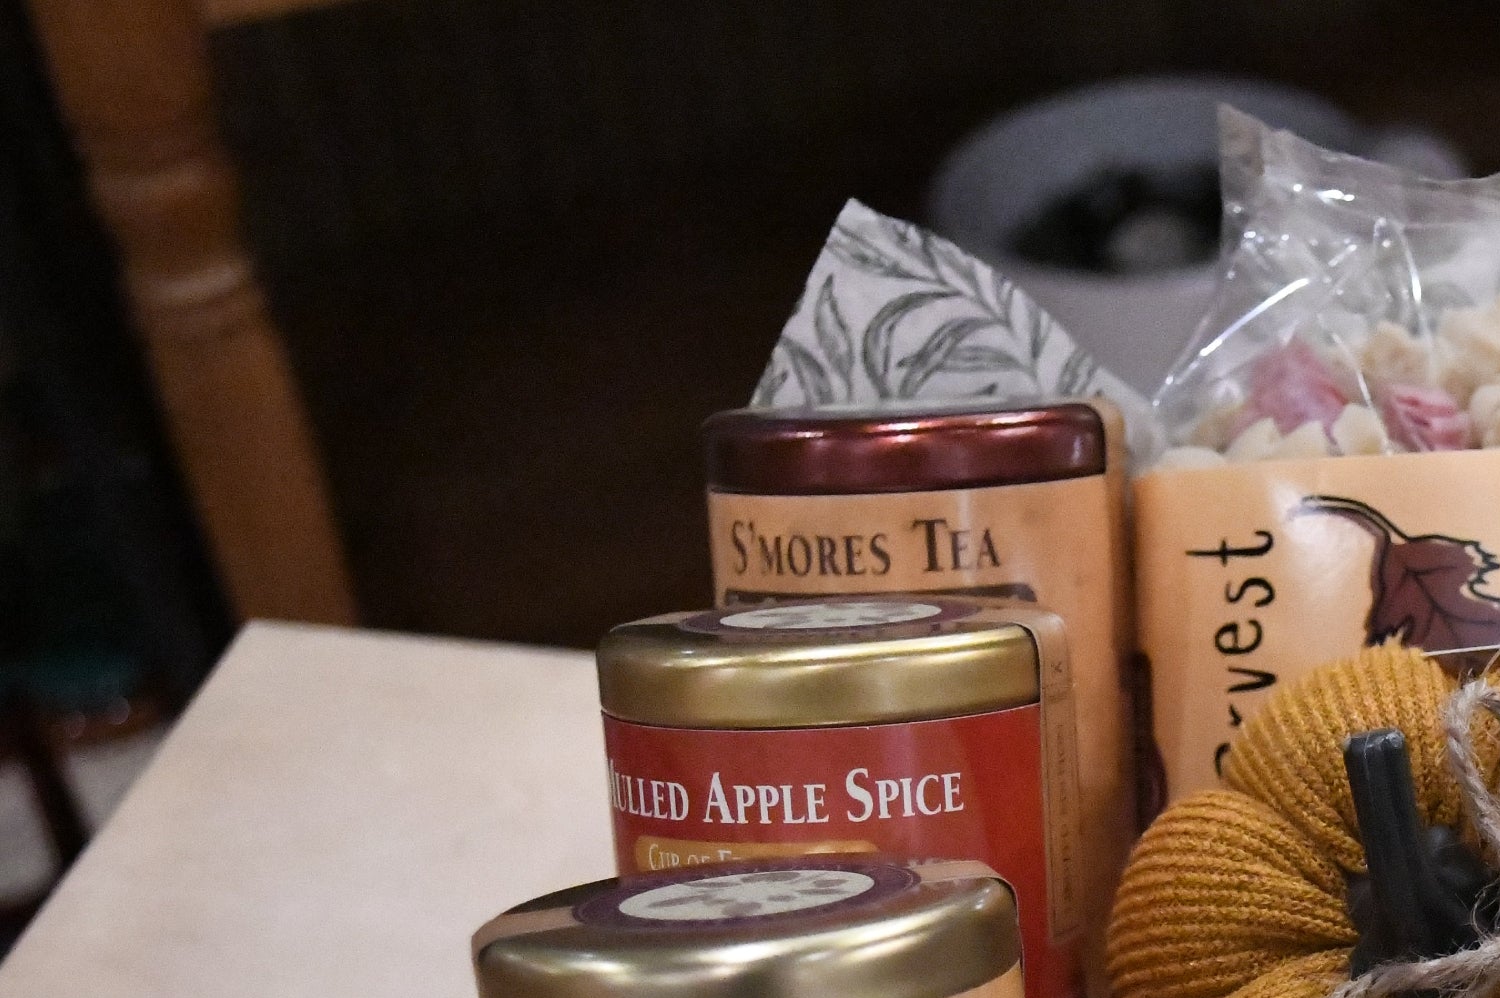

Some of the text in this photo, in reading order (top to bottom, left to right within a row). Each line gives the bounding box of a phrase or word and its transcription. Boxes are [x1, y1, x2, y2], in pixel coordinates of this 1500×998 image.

[731, 518, 1002, 578] S'MORES TEA
[703, 771, 830, 825] APPLE
[844, 766, 965, 824] SPICE
